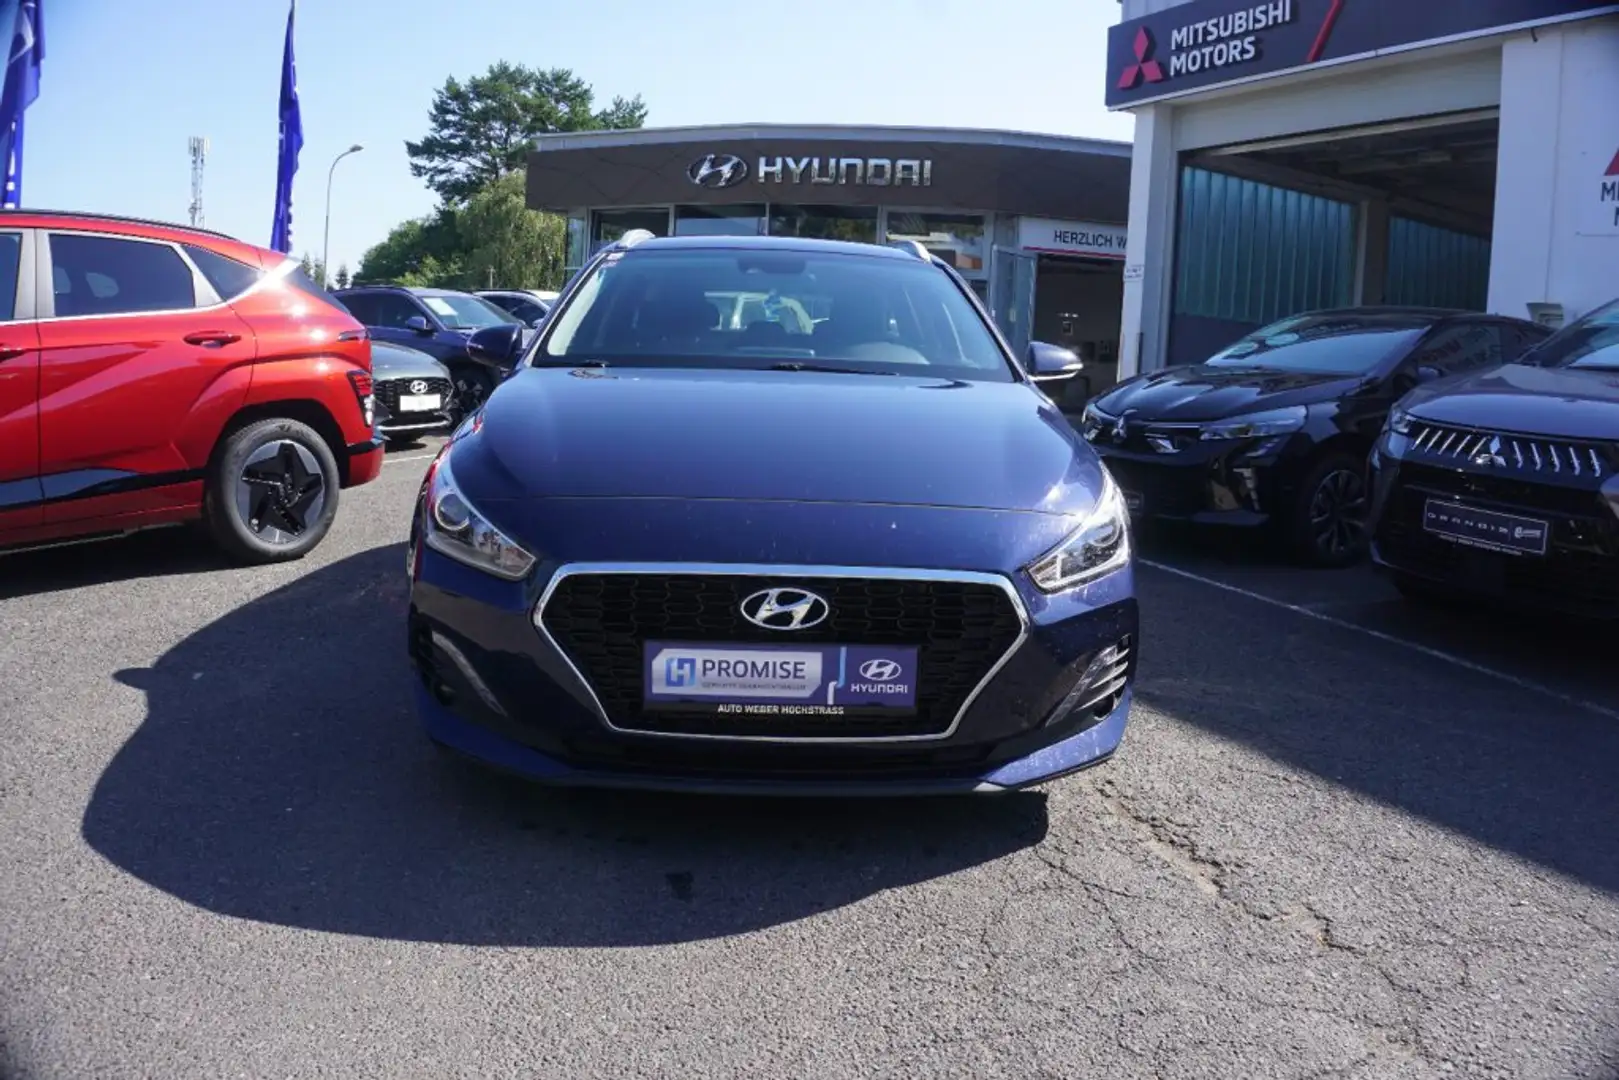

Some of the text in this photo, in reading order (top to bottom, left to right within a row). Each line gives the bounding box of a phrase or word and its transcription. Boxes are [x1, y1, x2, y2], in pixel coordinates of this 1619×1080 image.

[1171, 0, 1291, 50] MITSUBISHI
[1170, 36, 1256, 77] MOTORS
[757, 156, 932, 187] HYUNDAI
[1053, 229, 1113, 248] HERZLICH
[701, 659, 807, 680] PROMISE
[850, 683, 908, 694] HYUNDAI
[717, 703, 845, 716] AUTO WEBER HOCHSTRASS
